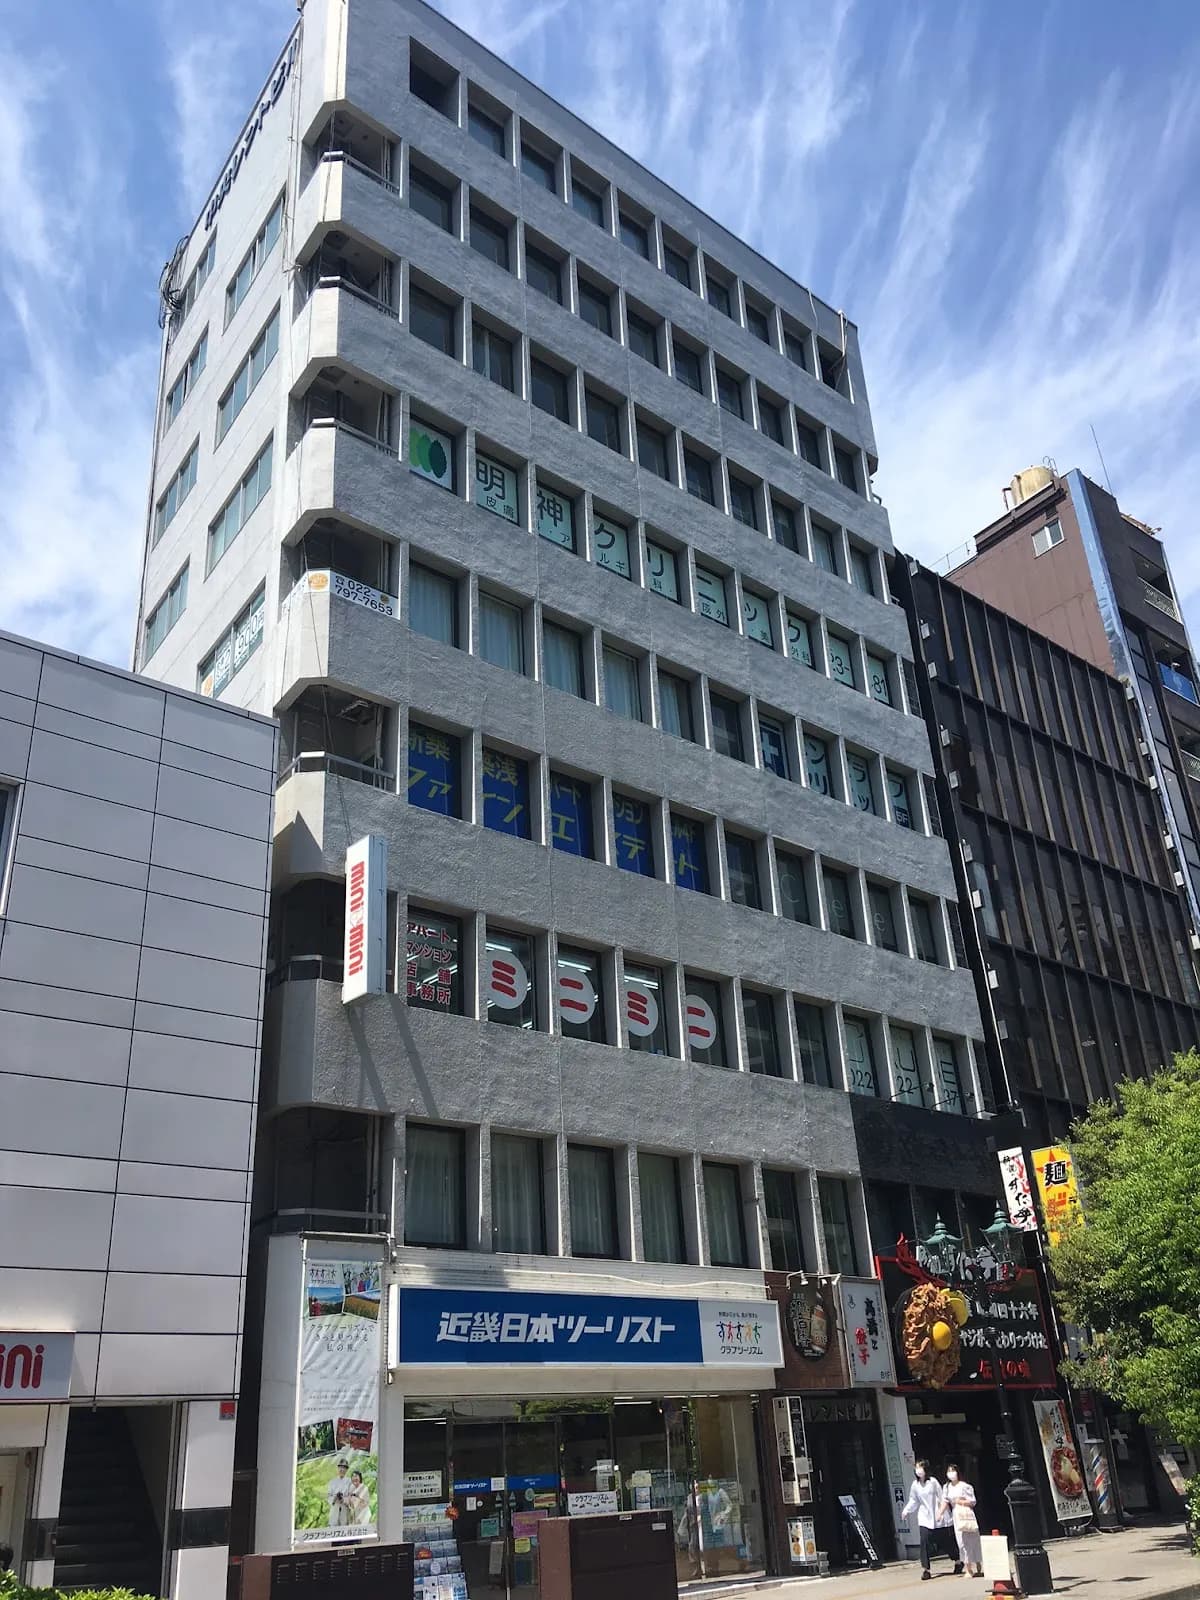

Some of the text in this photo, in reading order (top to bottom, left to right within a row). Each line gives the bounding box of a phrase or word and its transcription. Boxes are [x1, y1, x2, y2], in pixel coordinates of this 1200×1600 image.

[335, 584, 393, 616] 797-7653
[348, 860, 365, 977] mini mini
[406, 921, 451, 944] アパート
[406, 941, 453, 963] マンション
[406, 981, 451, 1005] 事務所
[1045, 1161, 1067, 1186] 麺
[436, 1311, 675, 1343] 近畿日本ツーリスト
[720, 1345, 763, 1355] クラブツーリズム
